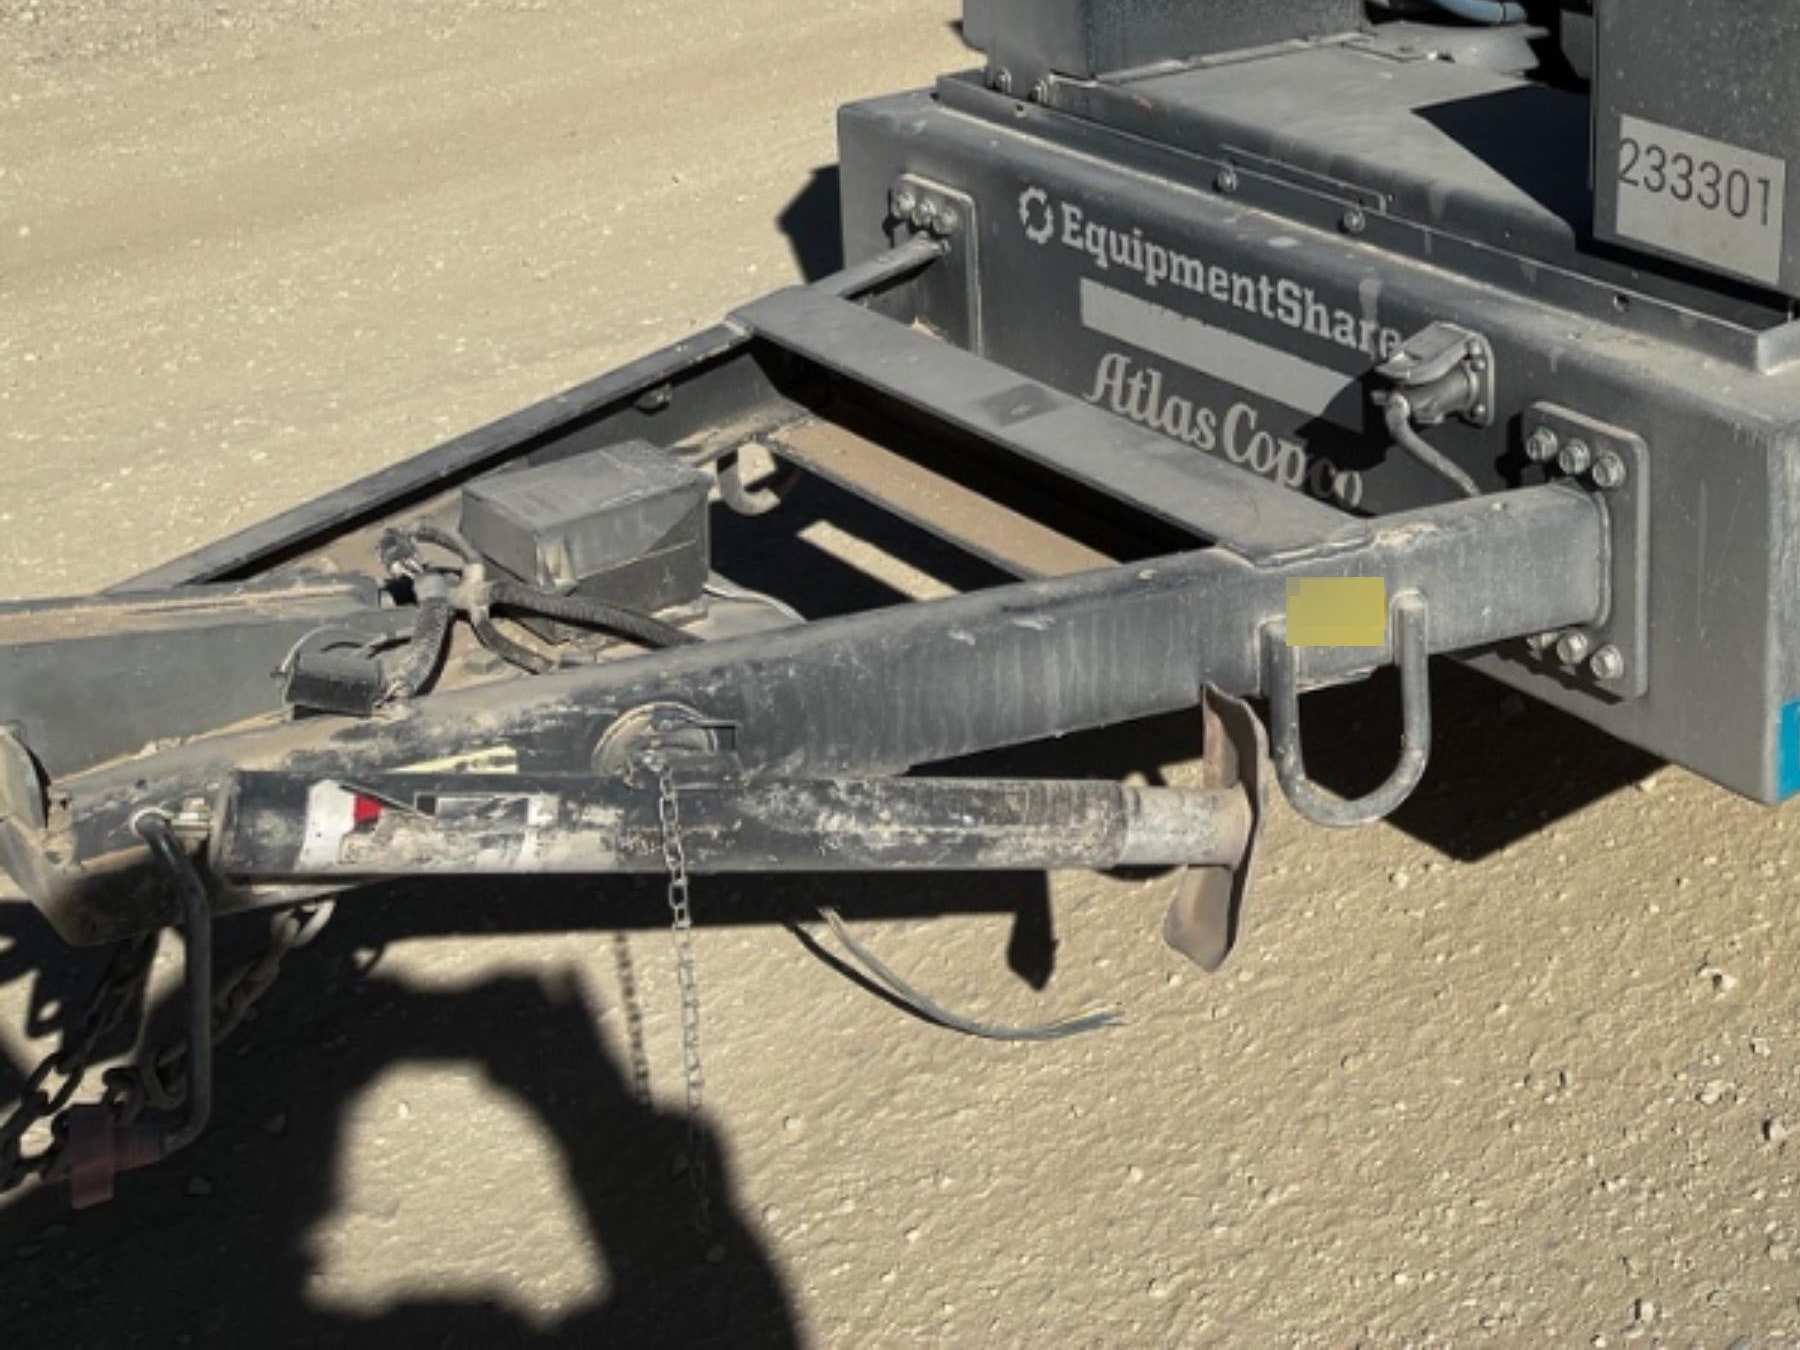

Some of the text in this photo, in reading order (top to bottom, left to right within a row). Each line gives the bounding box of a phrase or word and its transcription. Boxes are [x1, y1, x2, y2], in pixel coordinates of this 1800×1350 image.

[1618, 137, 1772, 227] 233301
[1060, 201, 1402, 358] EquipmentShare
[1085, 352, 1364, 508] Atlas Copco
